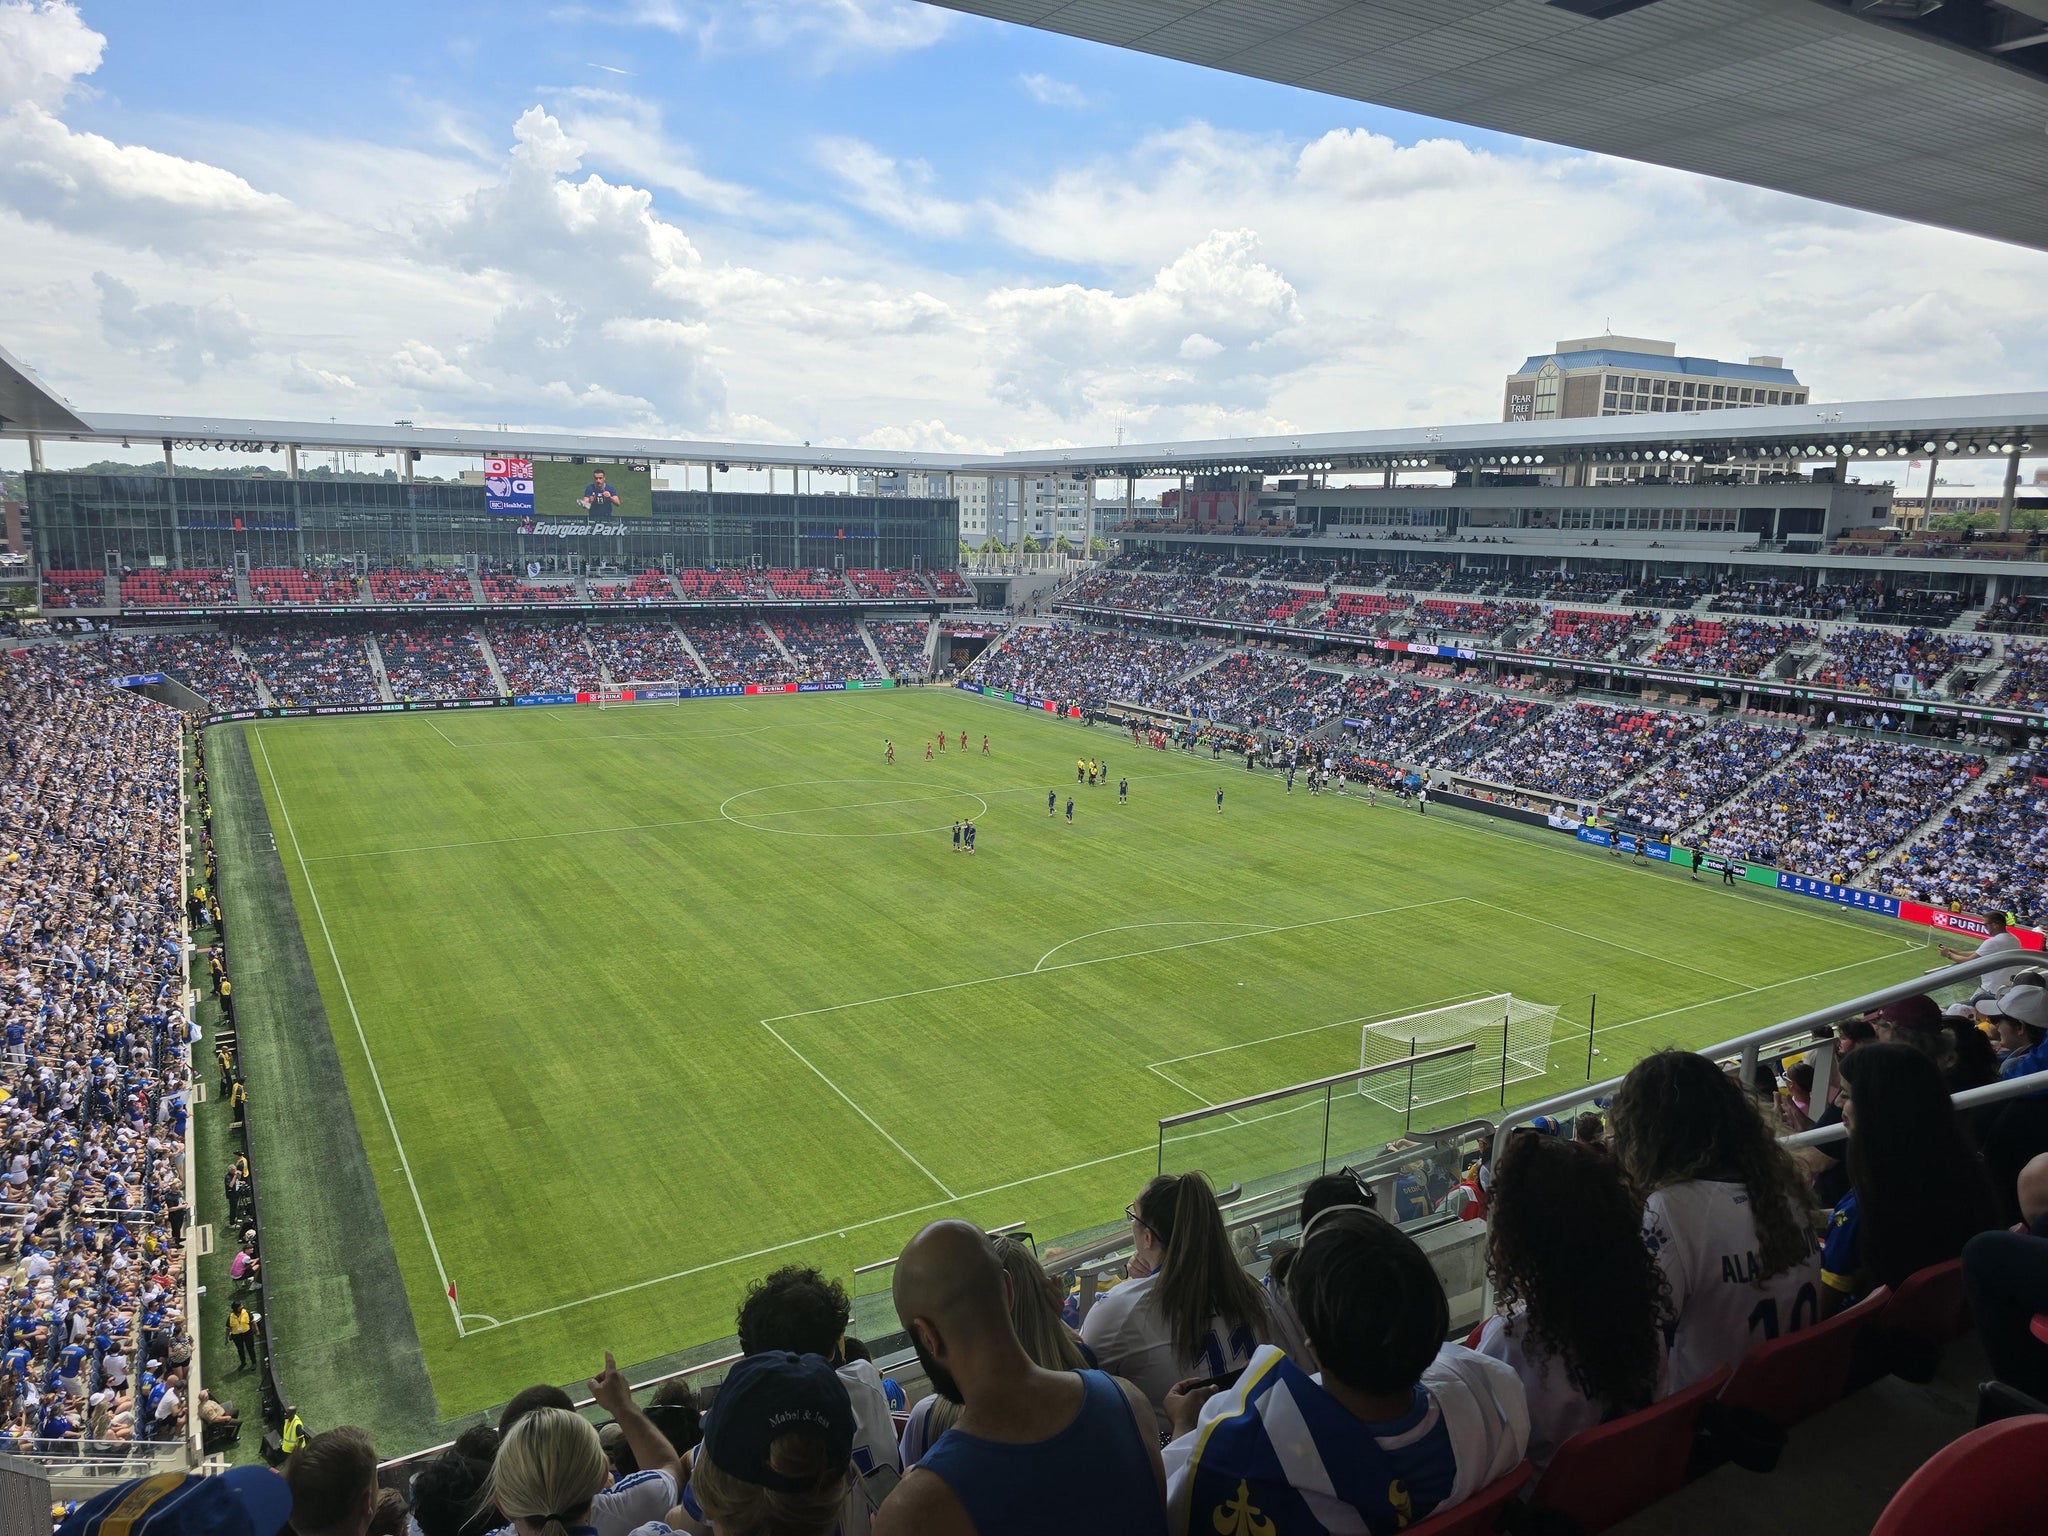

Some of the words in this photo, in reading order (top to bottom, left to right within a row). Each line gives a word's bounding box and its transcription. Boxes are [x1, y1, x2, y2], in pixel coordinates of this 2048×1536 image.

[1511, 394, 1532, 404] PEAR
[1510, 404, 1530, 413] TREE
[1513, 414, 1527, 422] INN
[533, 521, 592, 538] Energizer
[592, 523, 627, 536] Park
[1702, 859, 1746, 875] enterise
[1949, 917, 1990, 935] PURIN
[769, 1409, 800, 1428] Mabel
